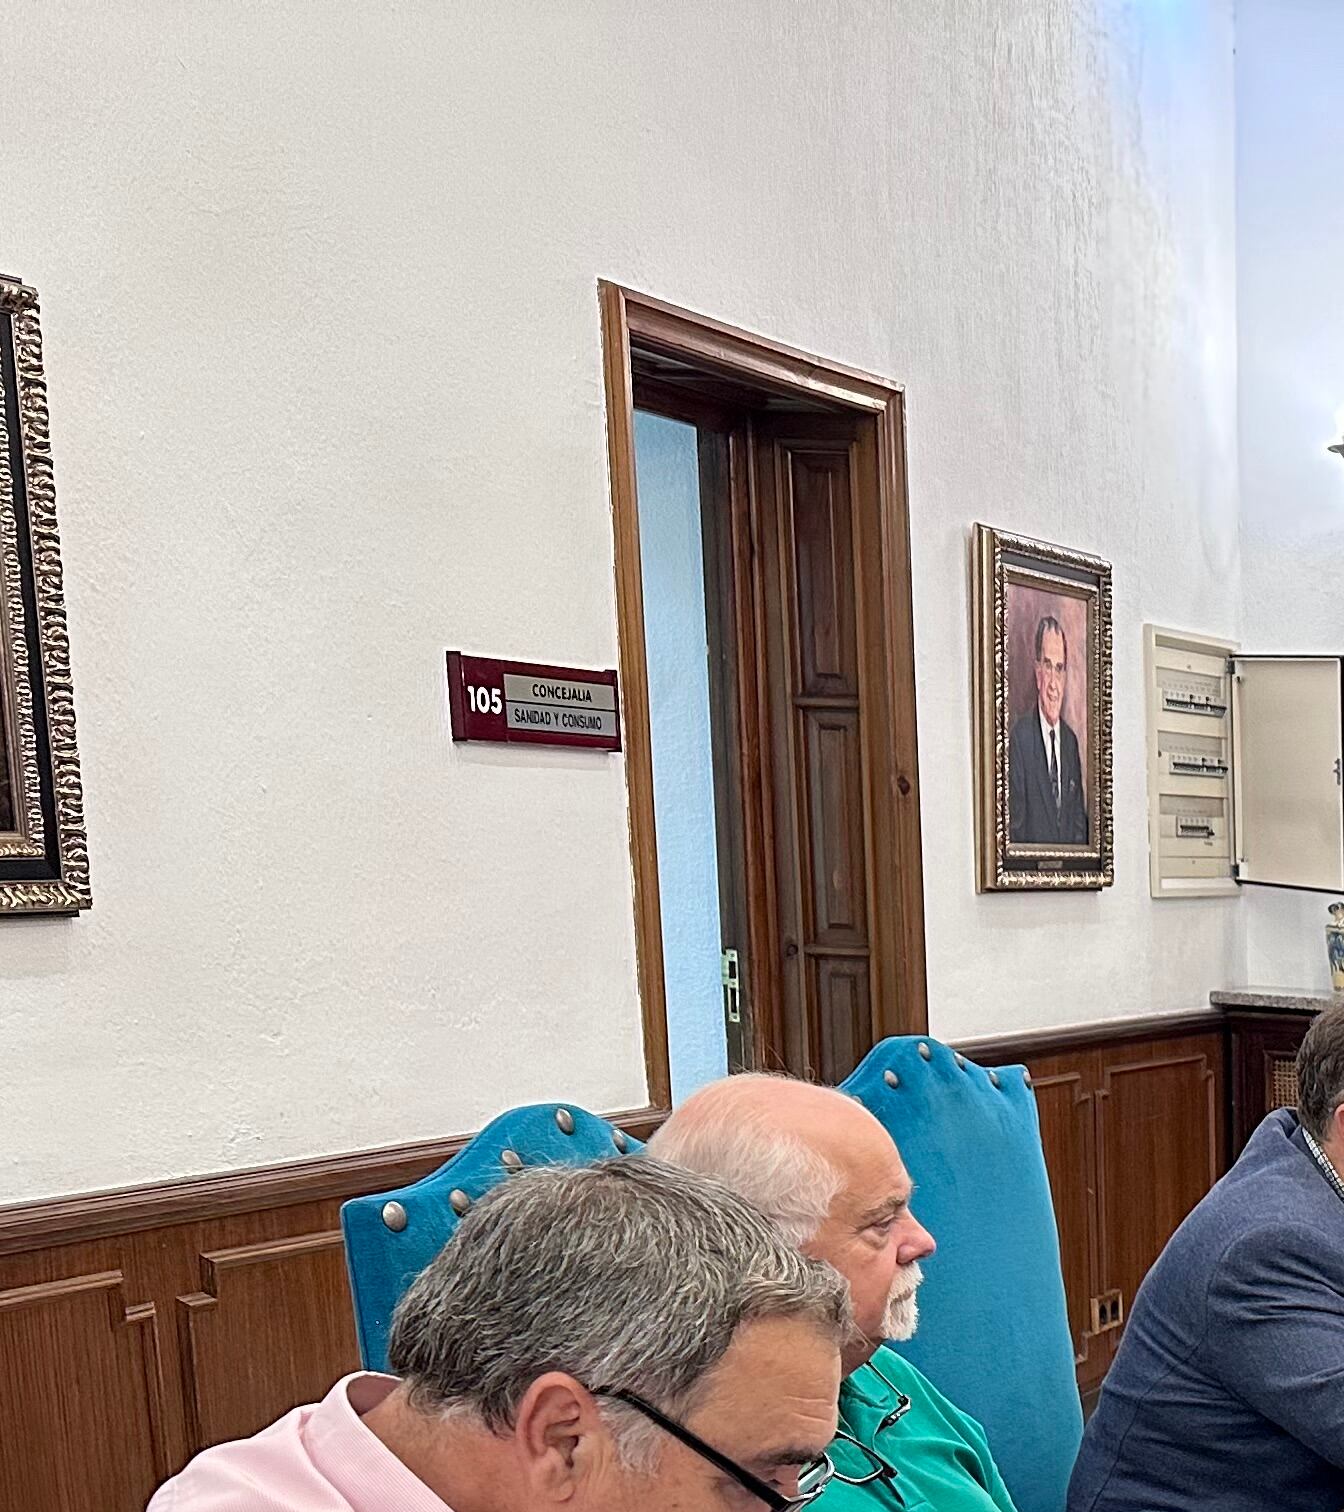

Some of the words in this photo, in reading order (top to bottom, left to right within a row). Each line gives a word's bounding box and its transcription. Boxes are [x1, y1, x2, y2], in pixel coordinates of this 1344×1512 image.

[467, 685, 503, 715] 105
[532, 684, 592, 703] CONCEJALIA
[514, 708, 551, 726] SANIDAD
[553, 712, 561, 727] Y
[562, 713, 602, 731] CONSUMO
